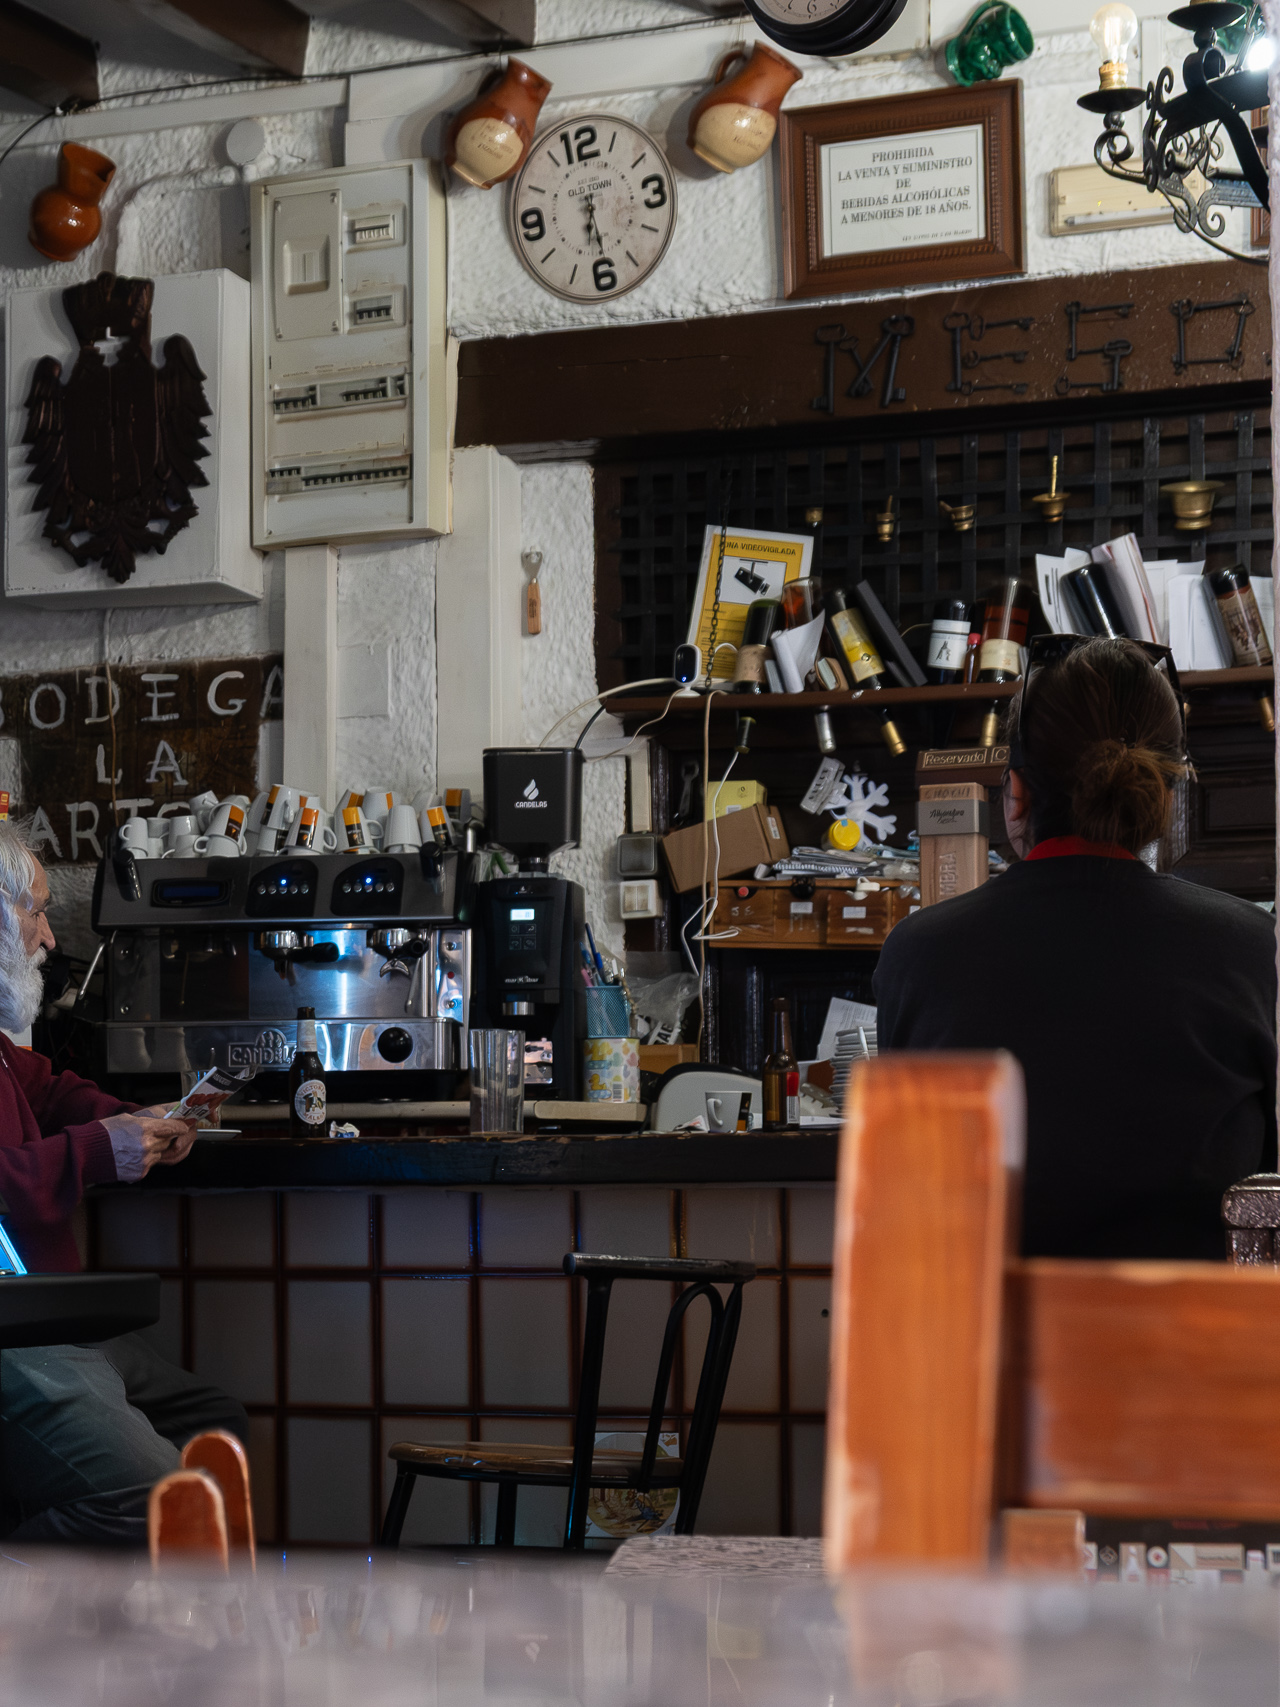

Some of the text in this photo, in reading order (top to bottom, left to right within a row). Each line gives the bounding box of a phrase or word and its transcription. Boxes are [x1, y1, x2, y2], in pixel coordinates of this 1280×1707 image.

[560, 125, 601, 165] 12
[872, 146, 934, 163] PROHIBIDA
[838, 156, 973, 182] LA VENTA Y SUMINISTRO
[568, 186, 586, 197] OLD
[587, 178, 612, 191] TOWN
[641, 173, 667, 209] 3
[896, 178, 911, 189] DE
[841, 185, 971, 210] BEBIDAS ALCOHÓLICAS
[521, 207, 546, 241] 9
[841, 214, 848, 224] A
[850, 207, 904, 224] MENORES
[907, 205, 922, 217] DE
[925, 203, 936, 215] 18
[592, 257, 618, 291] 6
[811, 299, 1256, 414] MESO
[741, 542, 797, 556] VIDEOVIGILADA
[96, 739, 189, 786] LA
[926, 752, 984, 765] Reservado
[939, 852, 957, 896] MBRA
